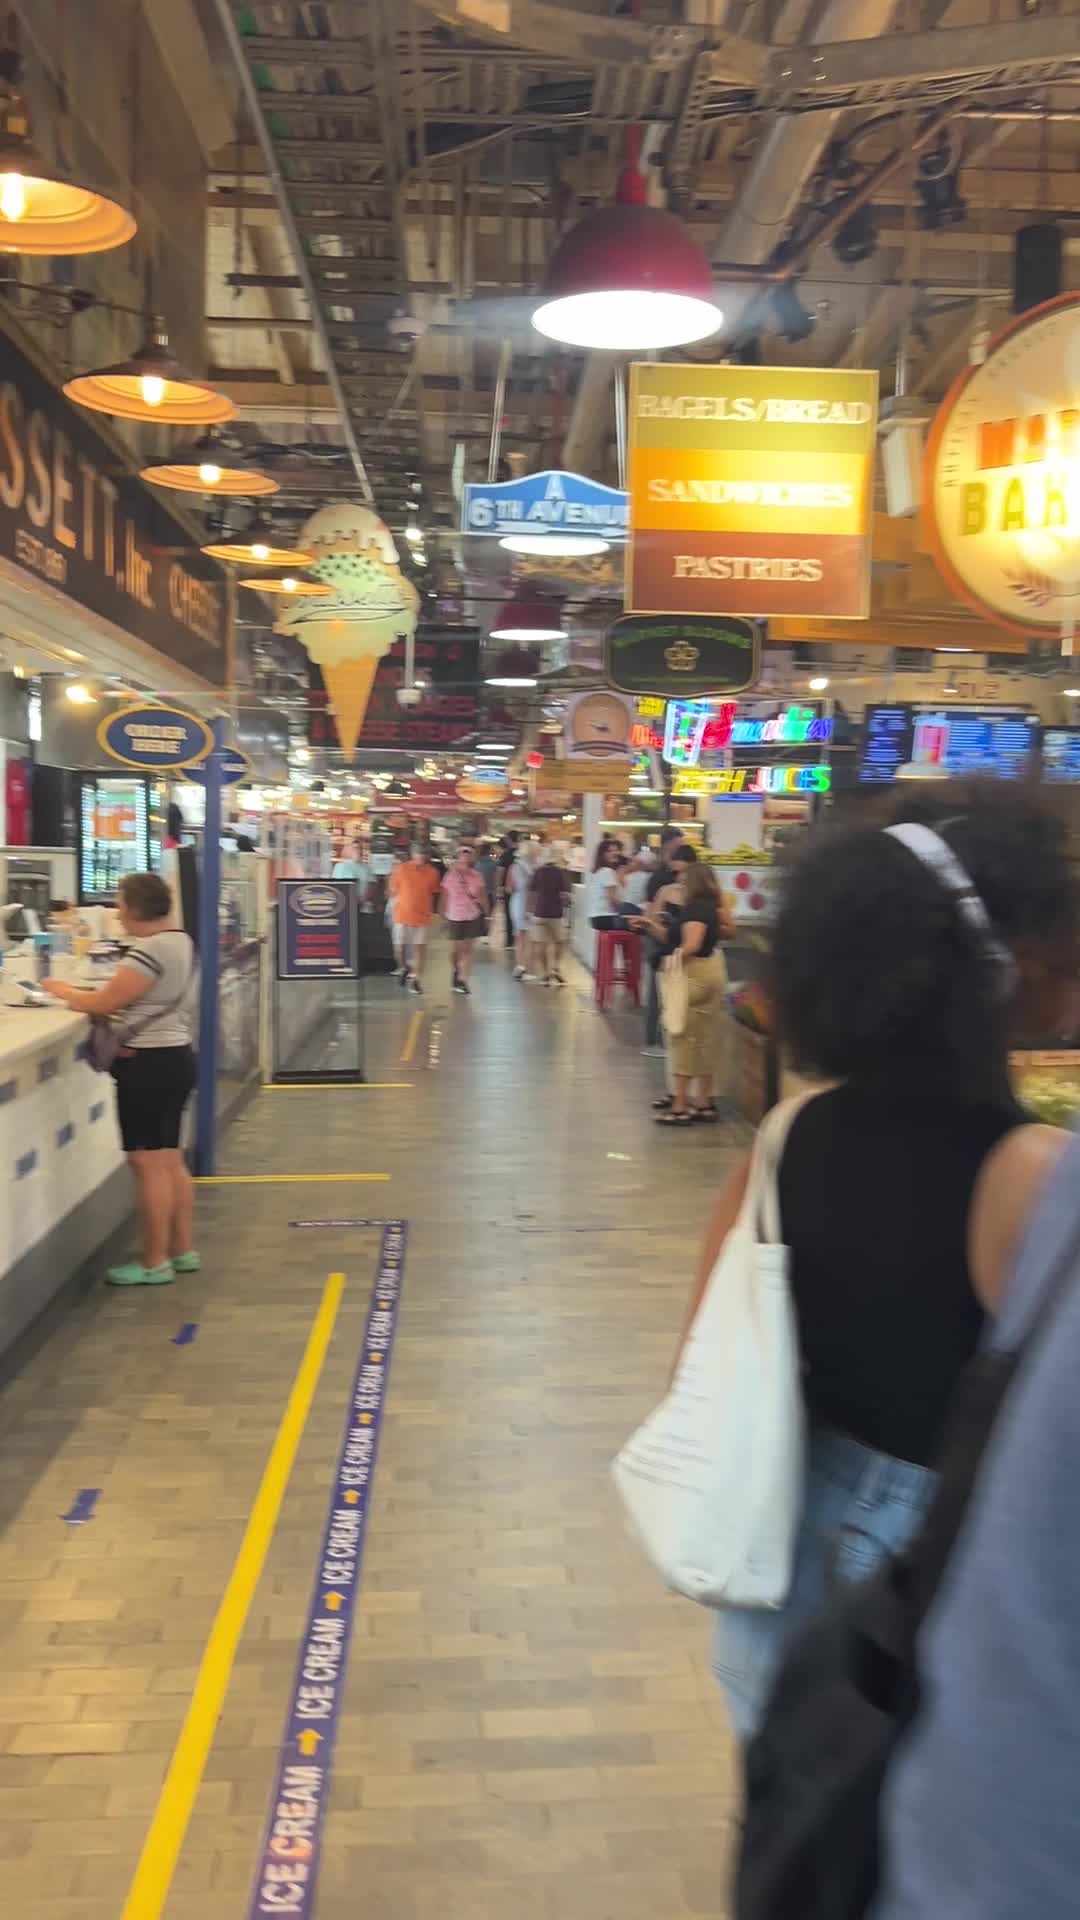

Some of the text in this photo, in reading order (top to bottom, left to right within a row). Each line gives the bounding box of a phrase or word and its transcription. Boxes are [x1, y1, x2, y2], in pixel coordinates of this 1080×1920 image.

[637, 395, 872, 424] BAGELS/BREAD
[469, 497, 525, 527] 6TH
[647, 479, 854, 508] SANDWICHES
[672, 555, 824, 582] PASTRIES
[339, 1427, 376, 1485] ICE CREAM
[321, 1510, 362, 1585] ICE CREAM
[294, 1618, 346, 1719] ICE CREAM
[258, 1765, 324, 1912] ICE CREAM
